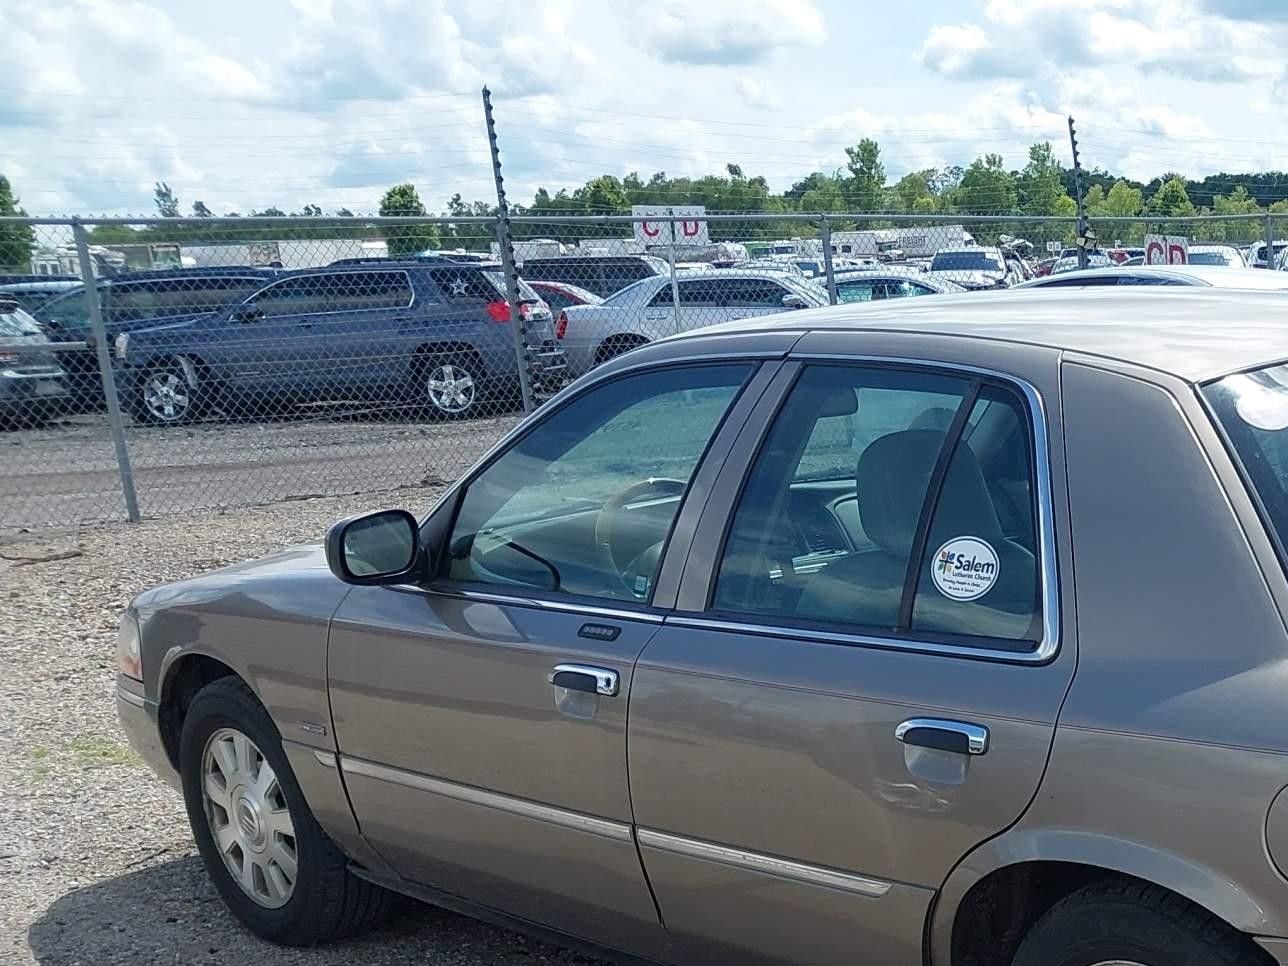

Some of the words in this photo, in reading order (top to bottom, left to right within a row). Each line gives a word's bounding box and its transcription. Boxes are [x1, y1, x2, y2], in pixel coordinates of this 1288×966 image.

[954, 553, 995, 575] Salem
[952, 569, 974, 579] Lutheran
[975, 573, 991, 582] Church
